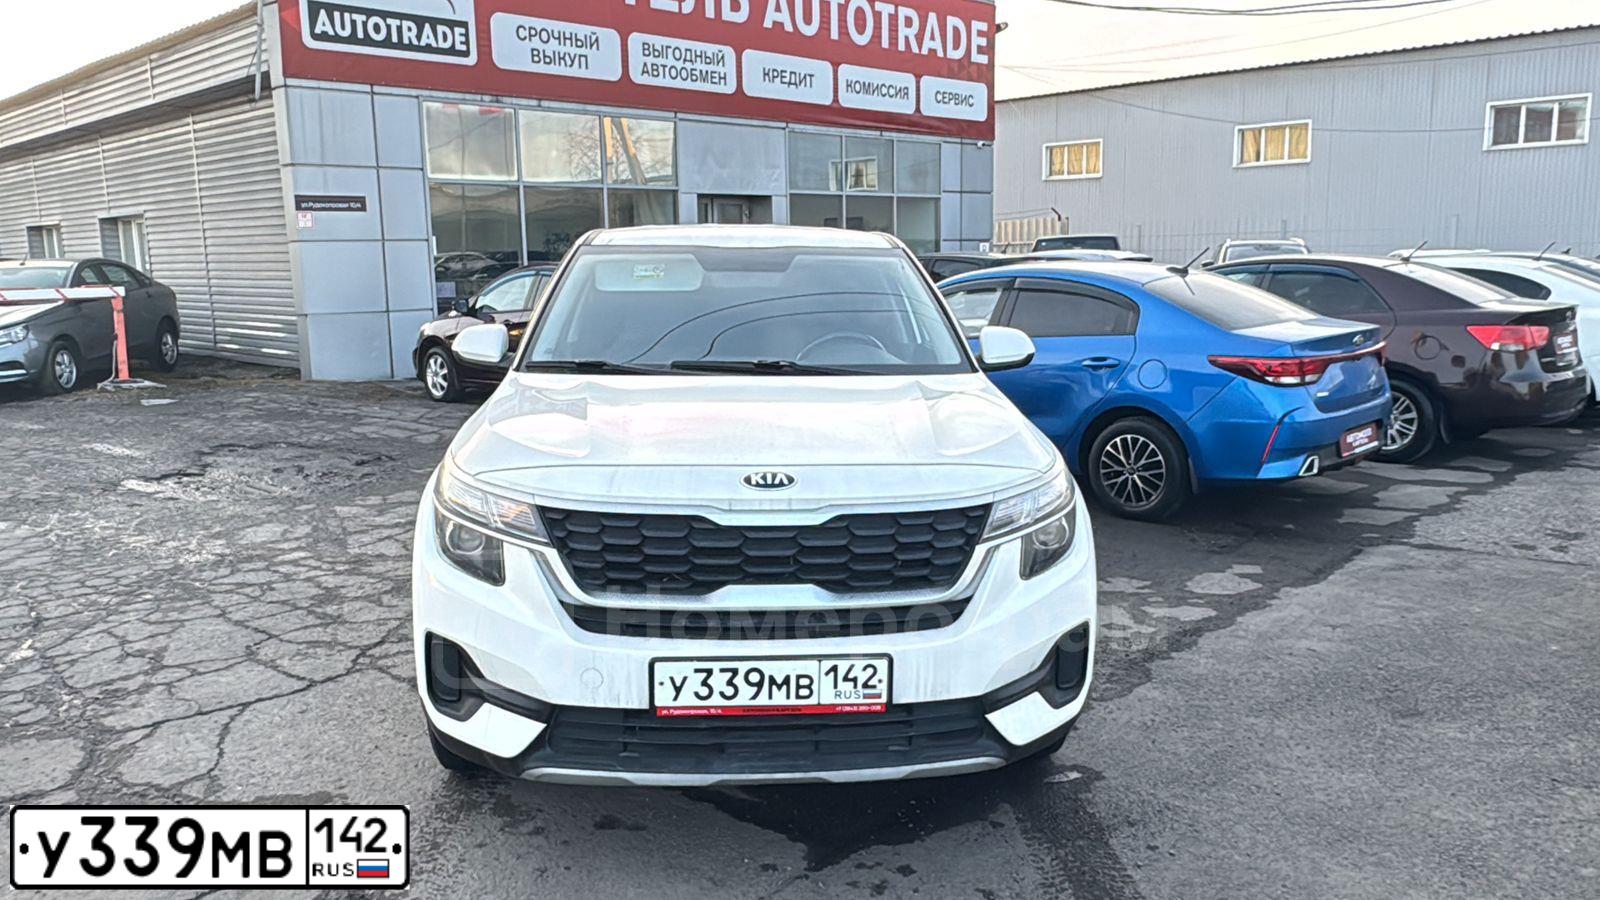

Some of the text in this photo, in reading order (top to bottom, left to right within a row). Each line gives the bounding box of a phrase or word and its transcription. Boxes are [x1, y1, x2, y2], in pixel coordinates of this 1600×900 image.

[313, 8, 468, 51] AUTOTRADE
[515, 24, 600, 51] СРОЧНЫЙ
[763, 0, 990, 65] AUTOTRADE
[530, 48, 590, 71] ВЫКУП
[642, 41, 726, 68] ВЫГОДНЫЙ
[640, 61, 727, 87] АВТООБМЕН
[762, 66, 815, 90] КРЕДИТ
[845, 78, 910, 101] КОМИССИЯ
[934, 90, 975, 108] СЕРВИС
[750, 472, 789, 485] KIA
[668, 663, 878, 702] У339МВ 142
[834, 689, 861, 700] RUS
